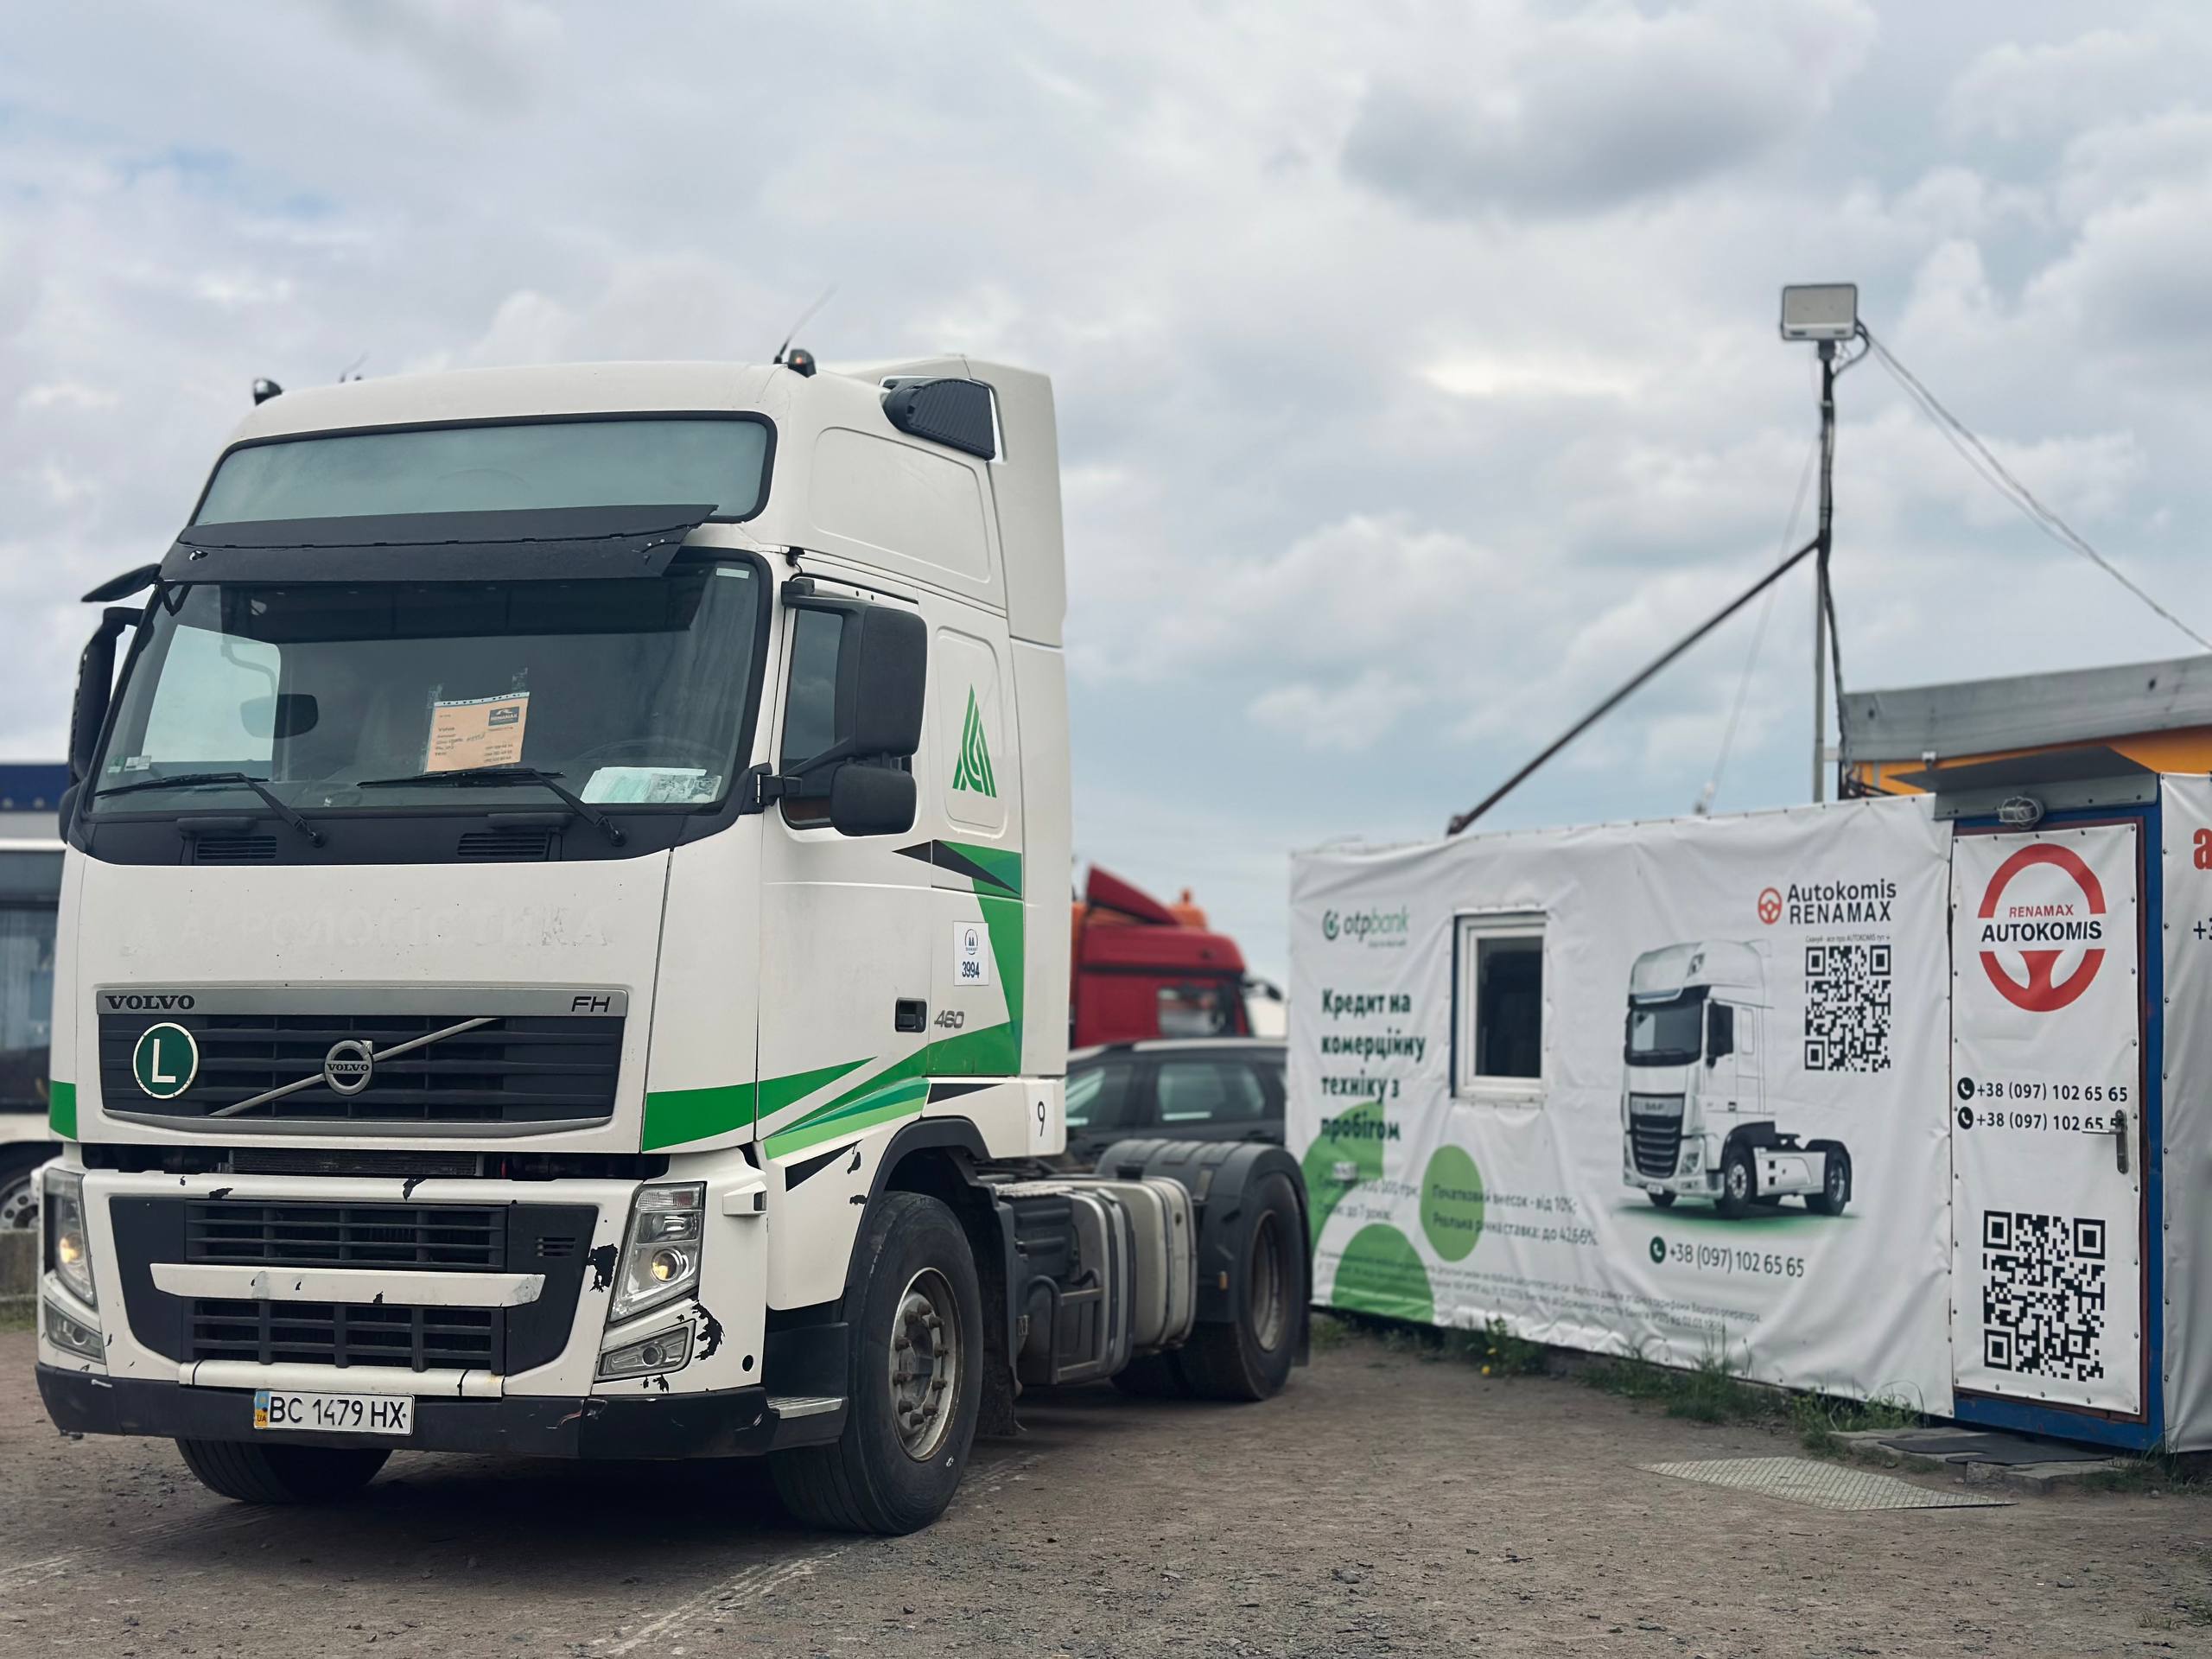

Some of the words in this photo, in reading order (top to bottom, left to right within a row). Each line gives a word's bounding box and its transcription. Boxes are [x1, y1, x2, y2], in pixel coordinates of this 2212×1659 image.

[1787, 878, 1897, 903] Autokomis
[1789, 900, 1891, 925] RENAMAX
[2009, 904, 2075, 918] RENAMAX
[1981, 920, 2103, 943] AUTOKOMIS
[962, 961, 980, 978] 3994
[105, 995, 195, 1010] VOLVO
[571, 996, 611, 1012] FH
[1322, 989, 1385, 1020] Кредит
[1389, 994, 1411, 1013] на
[934, 1010, 965, 1028] 460
[1321, 1027, 1427, 1063] комерційну
[151, 1039, 176, 1083] L
[1321, 1069, 1388, 1105] техніку
[1391, 1079, 1400, 1098] з
[1977, 1083, 2004, 1097] +38
[2009, 1082, 2047, 1101] (097)
[2053, 1084, 2080, 1101] 102
[2084, 1086, 2102, 1102] 65
[2108, 1086, 2127, 1103] 65
[1037, 1100, 1046, 1137] 9
[1321, 1110, 1401, 1144] пробігом
[1977, 1112, 2005, 1128] +38
[2009, 1111, 2048, 1131] (097)
[2053, 1115, 2081, 1131] 102
[1670, 1243, 1694, 1263] +38
[1697, 1244, 1733, 1274] (097)
[1736, 1251, 1760, 1273] 102
[1764, 1254, 1783, 1274] 65
[1786, 1257, 1805, 1278] 65
[270, 1396, 303, 1424] BC
[312, 1398, 364, 1427] 1479
[370, 1401, 405, 1429] HX
